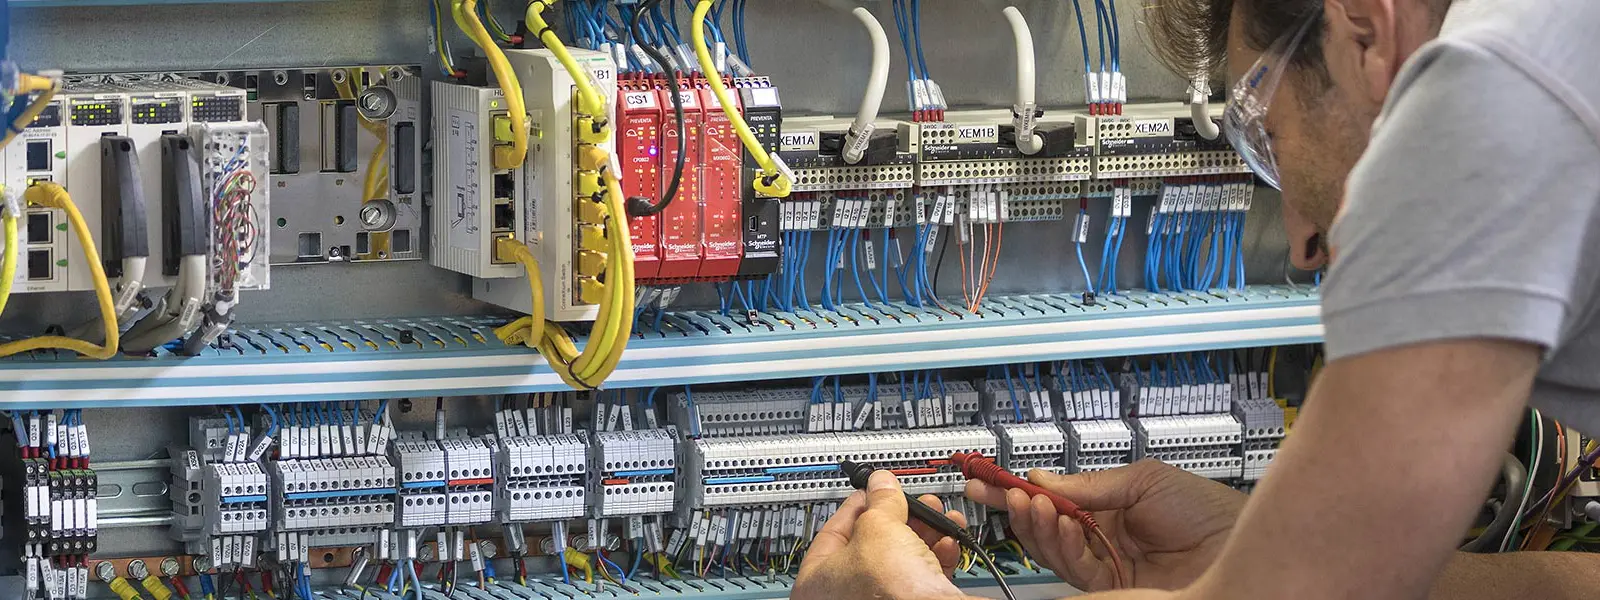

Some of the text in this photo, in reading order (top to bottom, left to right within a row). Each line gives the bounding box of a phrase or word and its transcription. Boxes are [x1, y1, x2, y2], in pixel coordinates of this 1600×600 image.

[627, 95, 648, 104] CS1
[1135, 123, 1169, 133] XEM2A
[959, 128, 995, 138] XEM1B
[779, 135, 815, 146] XEM1A
[924, 145, 950, 153] Schneider
[668, 244, 696, 252] Schneider
[708, 241, 736, 250] Schneider
[748, 240, 776, 249] Schneider
[254, 443, 267, 456] 0V2A
